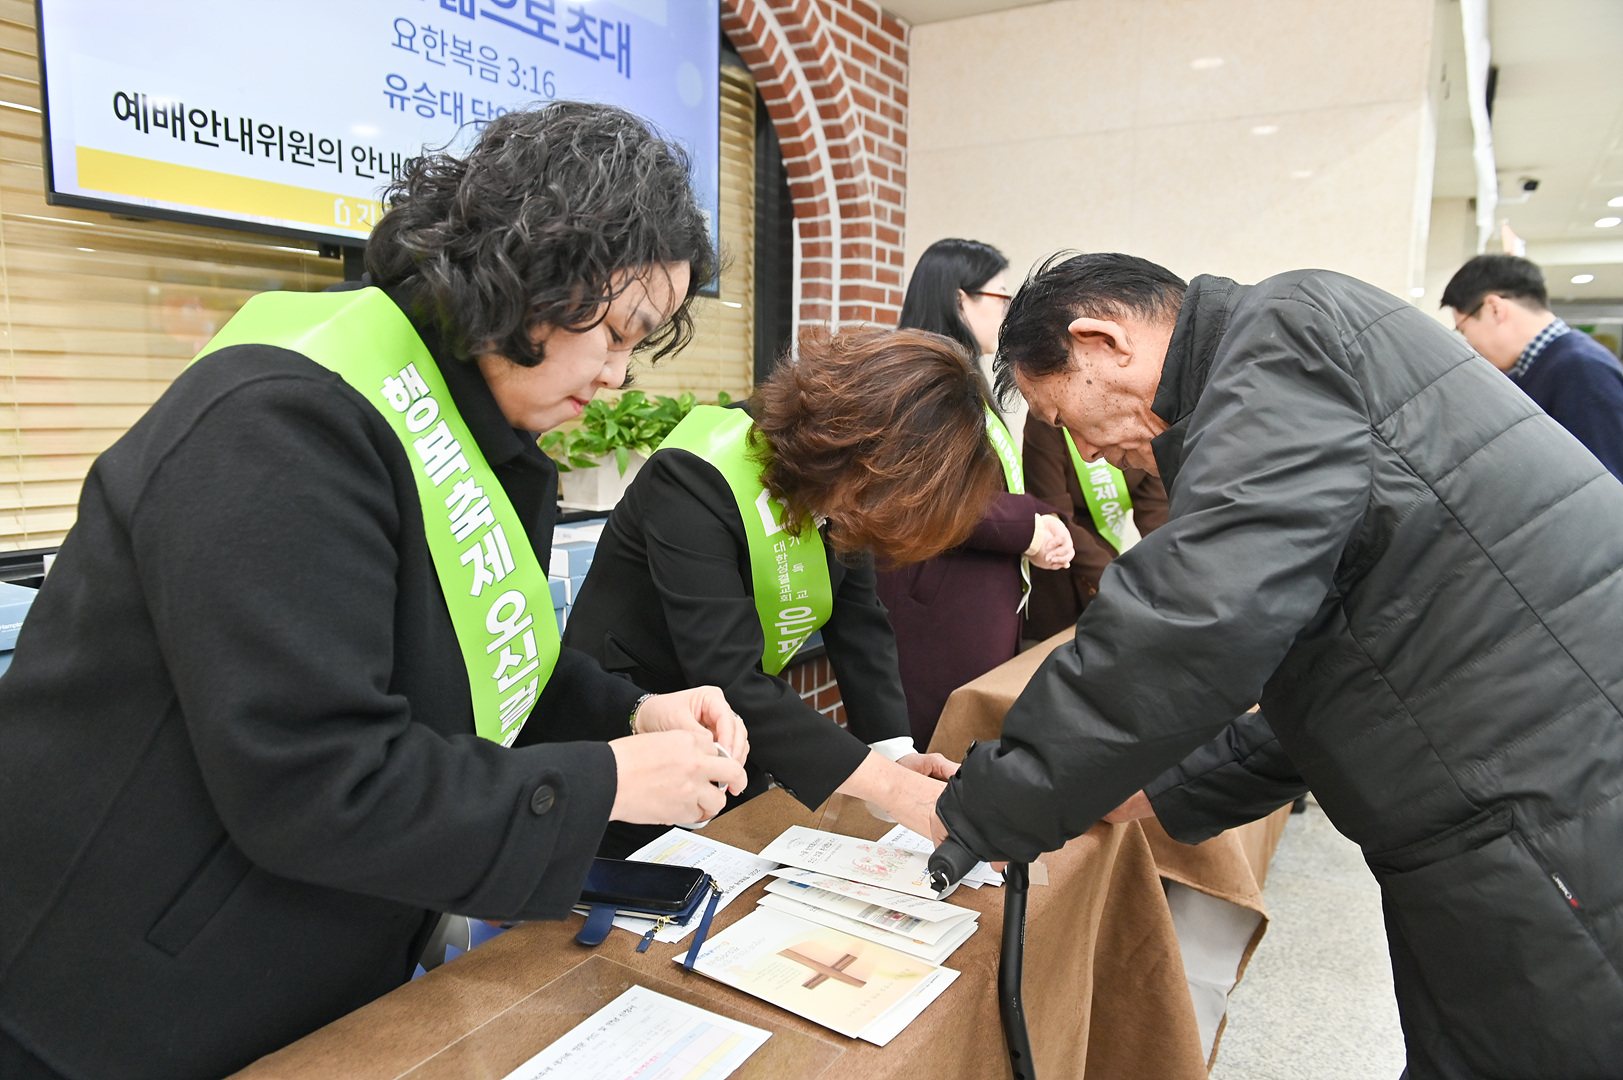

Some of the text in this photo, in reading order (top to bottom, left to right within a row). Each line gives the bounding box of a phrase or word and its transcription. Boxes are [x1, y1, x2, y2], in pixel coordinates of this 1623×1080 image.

[391, 17, 556, 98] 요한복음 3:16
[113, 91, 343, 174] 예배안내위원의
[383, 73, 464, 127] 유승대
[380, 361, 517, 598] 행복축제
[773, 540, 792, 602] 대한성결교회
